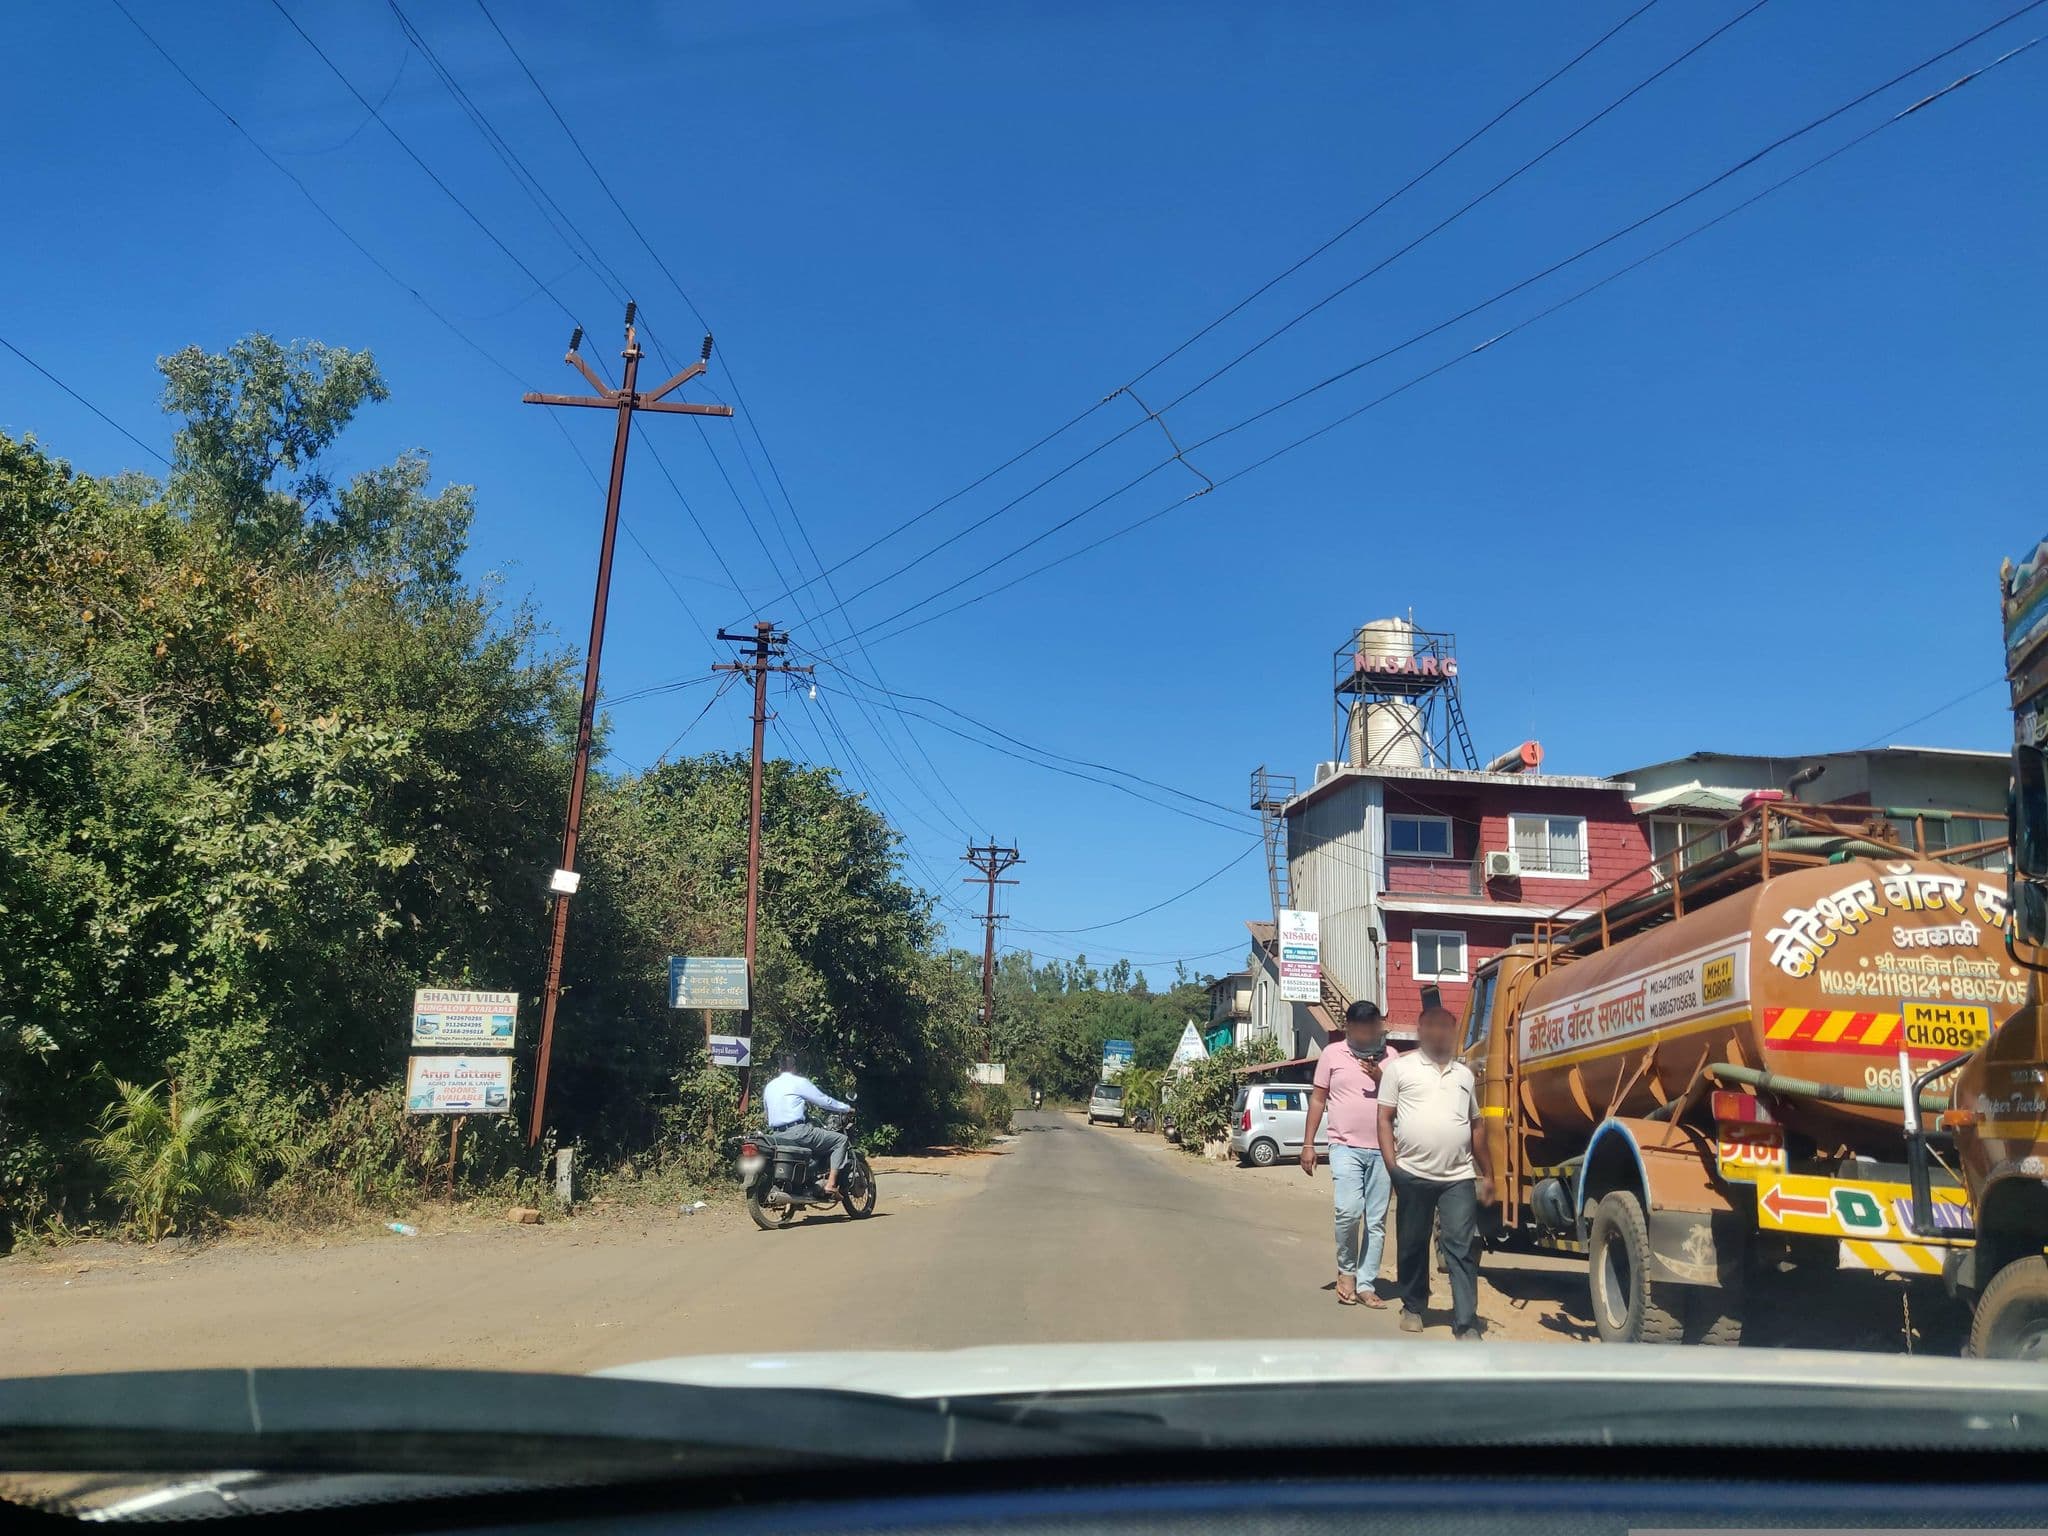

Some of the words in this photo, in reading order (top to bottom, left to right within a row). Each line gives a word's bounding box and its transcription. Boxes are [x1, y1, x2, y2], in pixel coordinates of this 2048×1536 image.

[1355, 653, 1458, 677] NISARG
[1879, 862, 1967, 914] वॉटर
[1283, 931, 1318, 941] NISARG
[1892, 919, 1981, 949] अवकाळी
[423, 992, 471, 1002] SHANTI
[476, 993, 512, 1004] VILLA
[417, 1004, 466, 1013] BUNGALOW
[467, 1005, 514, 1014] AVAILABLE
[1567, 1002, 1595, 1041] वॉटर
[421, 1069, 450, 1080] Arya
[454, 1069, 502, 1081] Cottage
